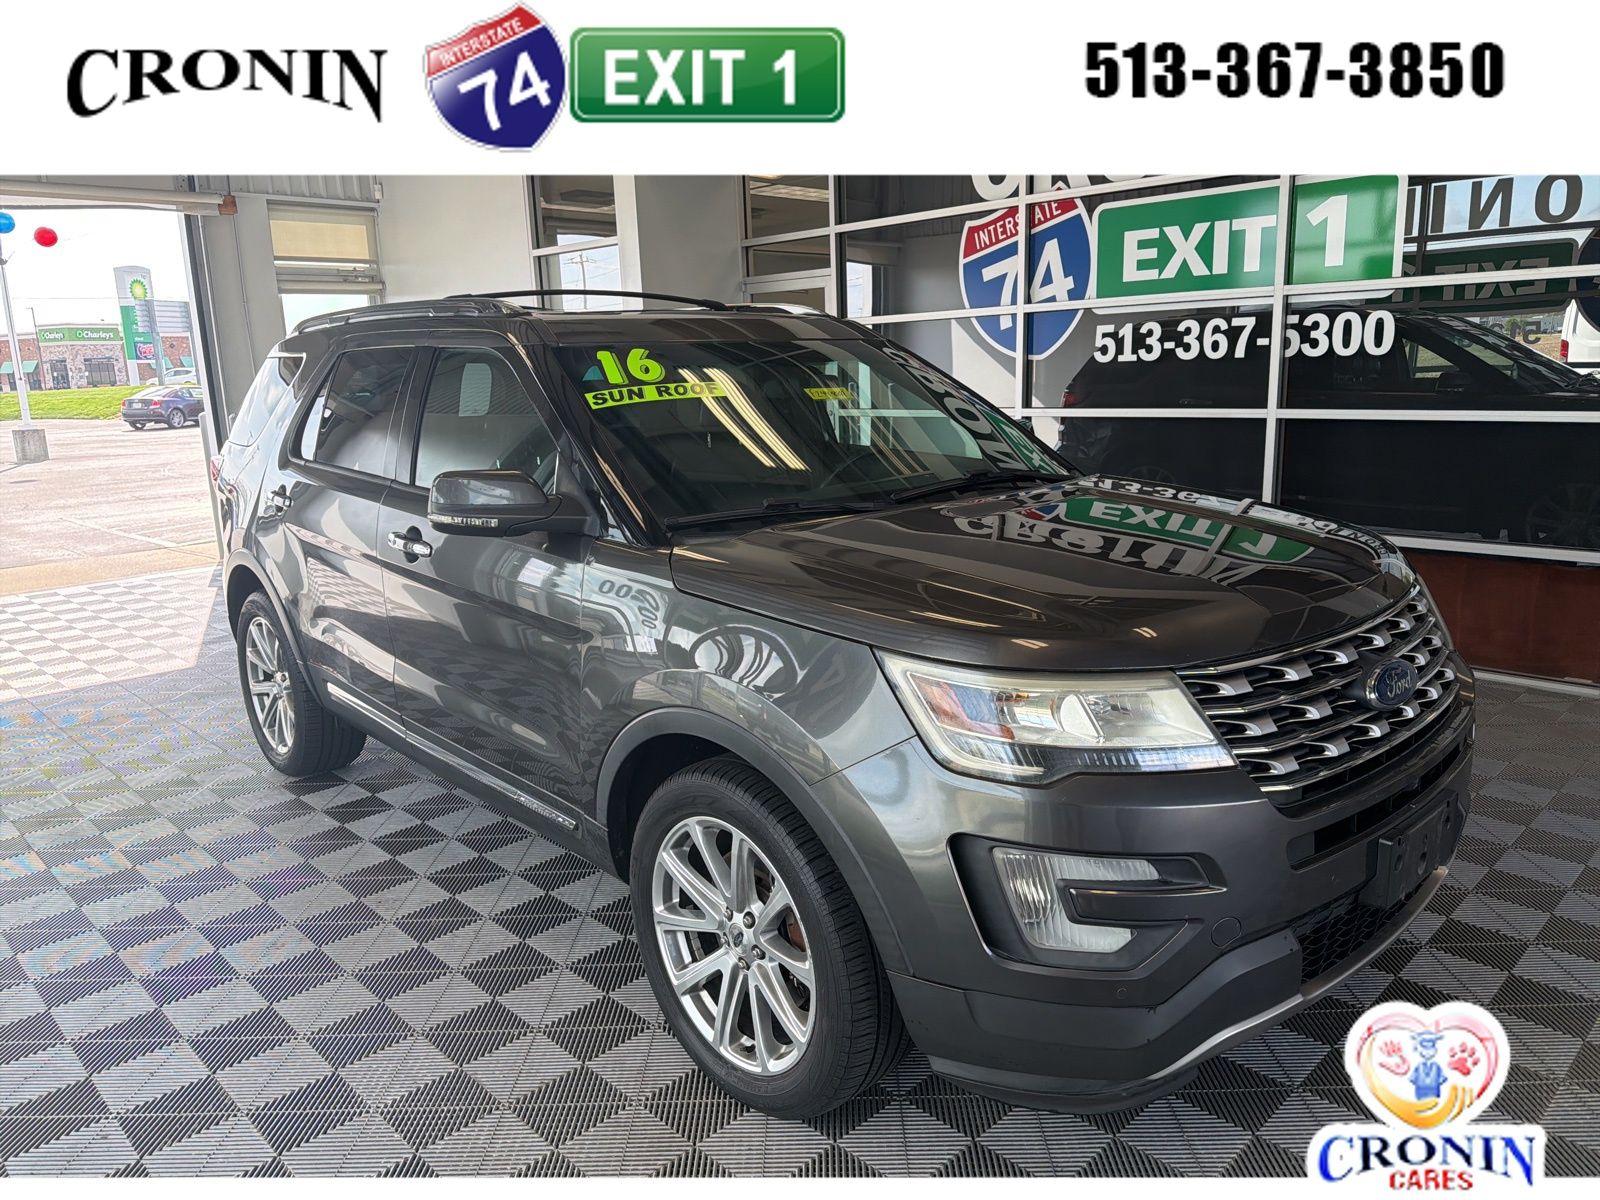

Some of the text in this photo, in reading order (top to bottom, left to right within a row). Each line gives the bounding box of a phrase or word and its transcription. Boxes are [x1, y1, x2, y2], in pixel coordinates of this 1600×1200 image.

[1123, 195, 1348, 282] EXIT 1
[982, 238, 1075, 331] 74
[1093, 310, 1396, 363] 513-367-5300
[597, 348, 665, 384] 16
[591, 381, 722, 407] SUN ROOF
[1386, 666, 1411, 697] Ford
